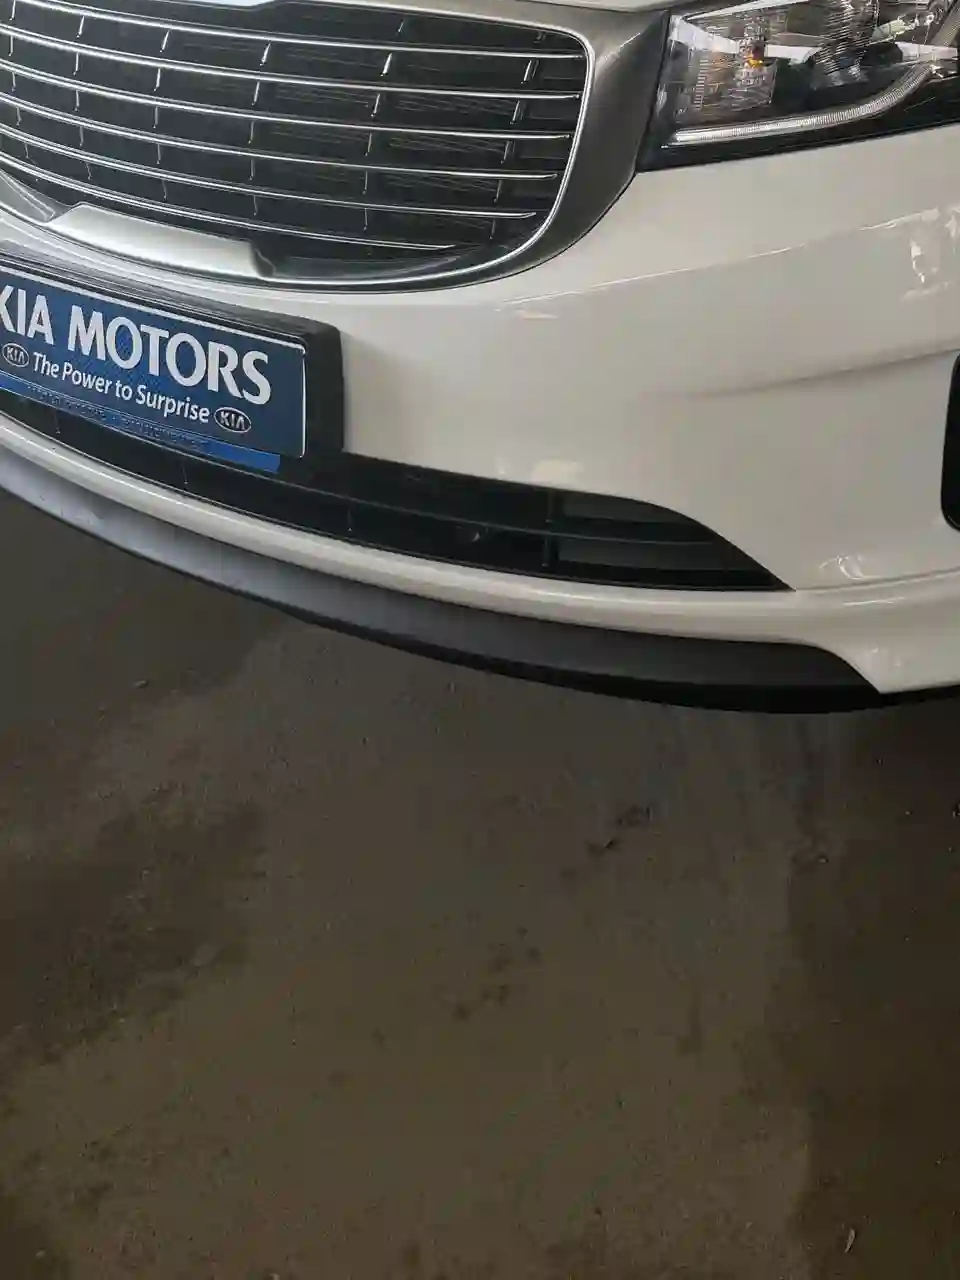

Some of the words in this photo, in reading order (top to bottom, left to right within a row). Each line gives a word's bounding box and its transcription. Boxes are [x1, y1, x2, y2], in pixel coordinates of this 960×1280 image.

[0, 284, 54, 346] KIA
[67, 304, 272, 406] MOTORS
[5, 345, 26, 365] KIA
[33, 351, 60, 379] The
[61, 361, 113, 395] Power
[115, 379, 133, 402] to
[135, 383, 211, 424] Surprise
[218, 410, 247, 431] KIA
